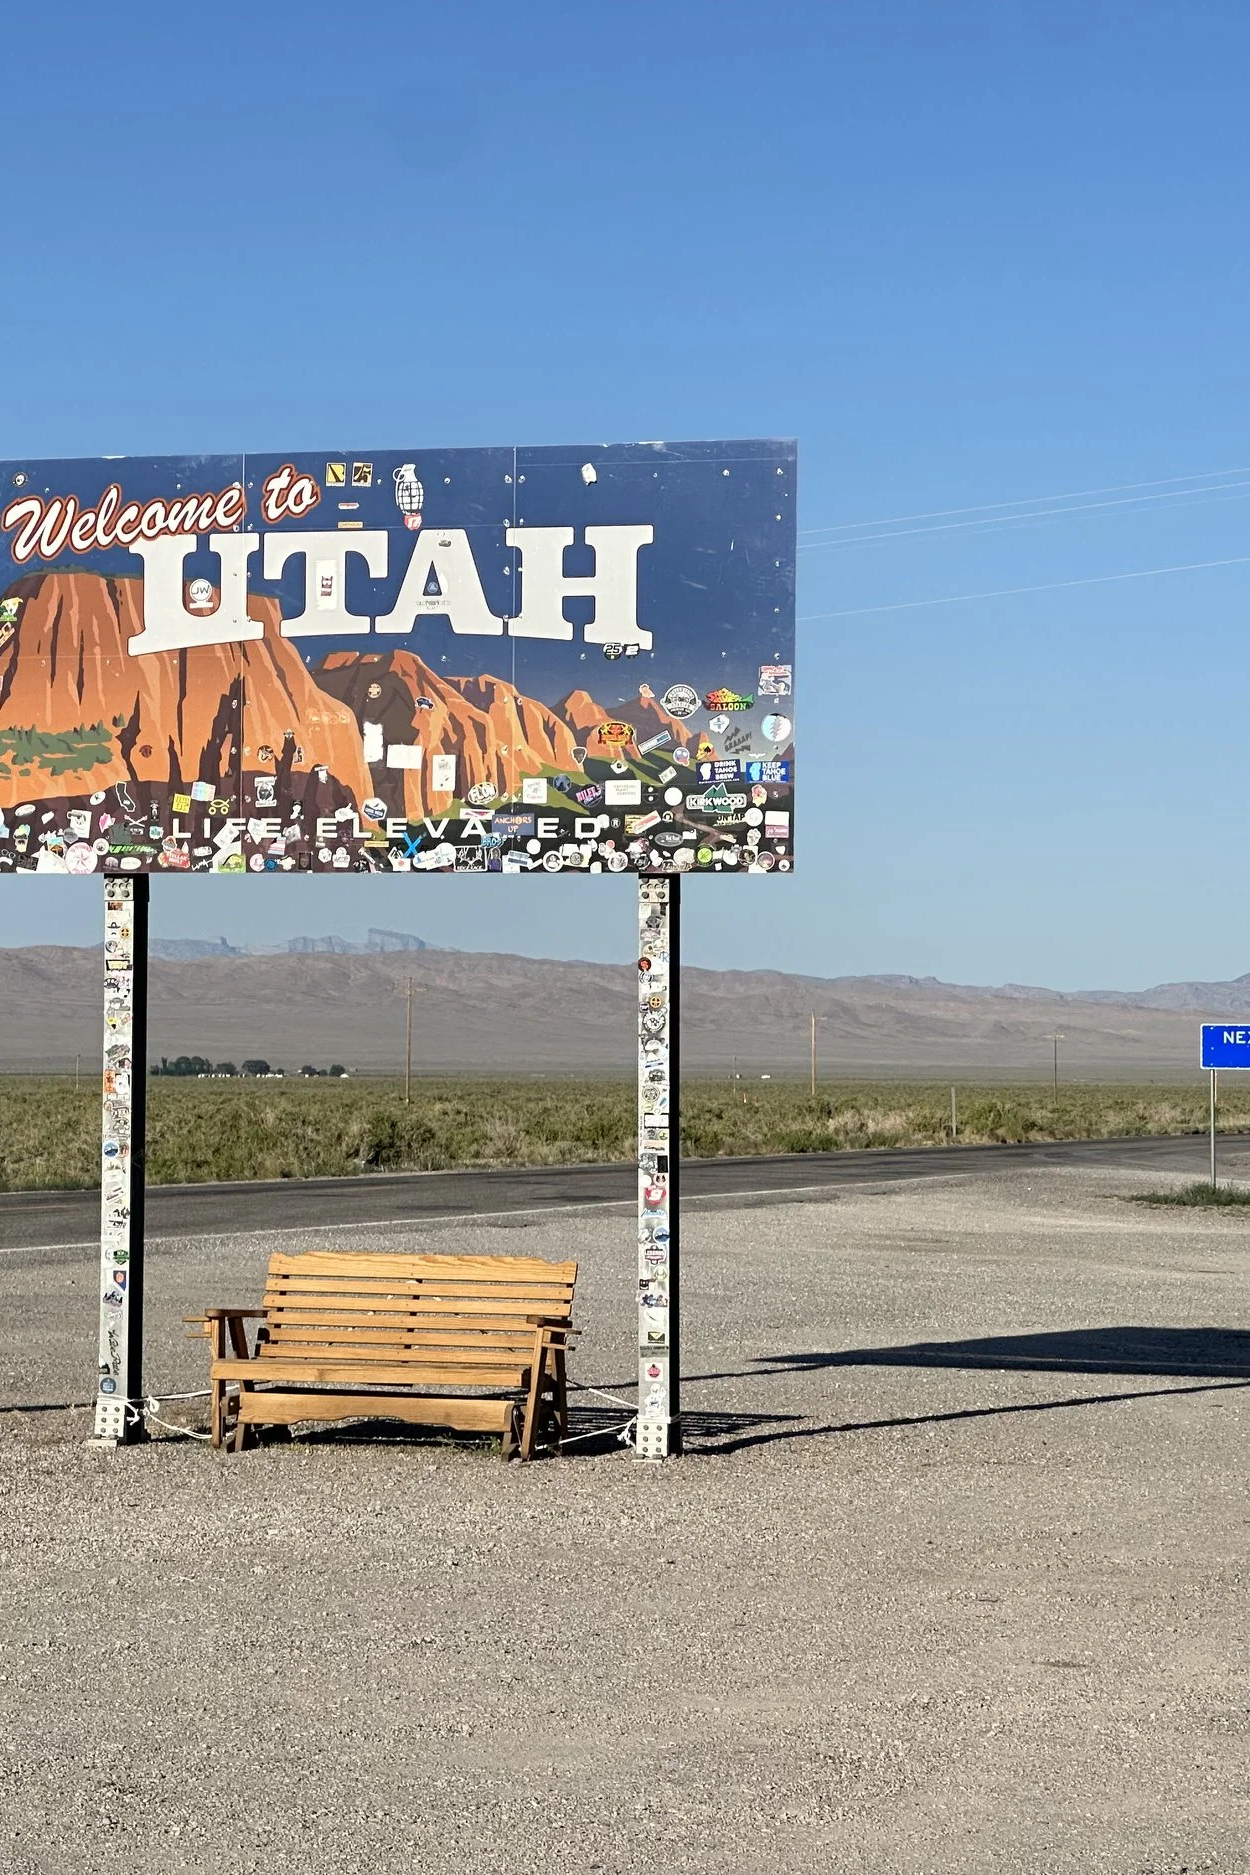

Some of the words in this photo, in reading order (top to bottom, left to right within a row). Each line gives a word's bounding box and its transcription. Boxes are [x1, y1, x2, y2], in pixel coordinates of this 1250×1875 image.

[1, 483, 245, 563] Welcome
[261, 463, 321, 523] to
[128, 525, 654, 657] UTAH
[710, 703, 747, 711] SALOON
[714, 760, 737, 768] DRINK
[689, 796, 745, 807] KIRKWOOD
[494, 816, 532, 825] ANCHORS
[730, 813, 746, 821] TAP
[316, 817, 601, 838] ELEVAED
[508, 825, 519, 833] UP
[1223, 1031, 1250, 1044] NE
